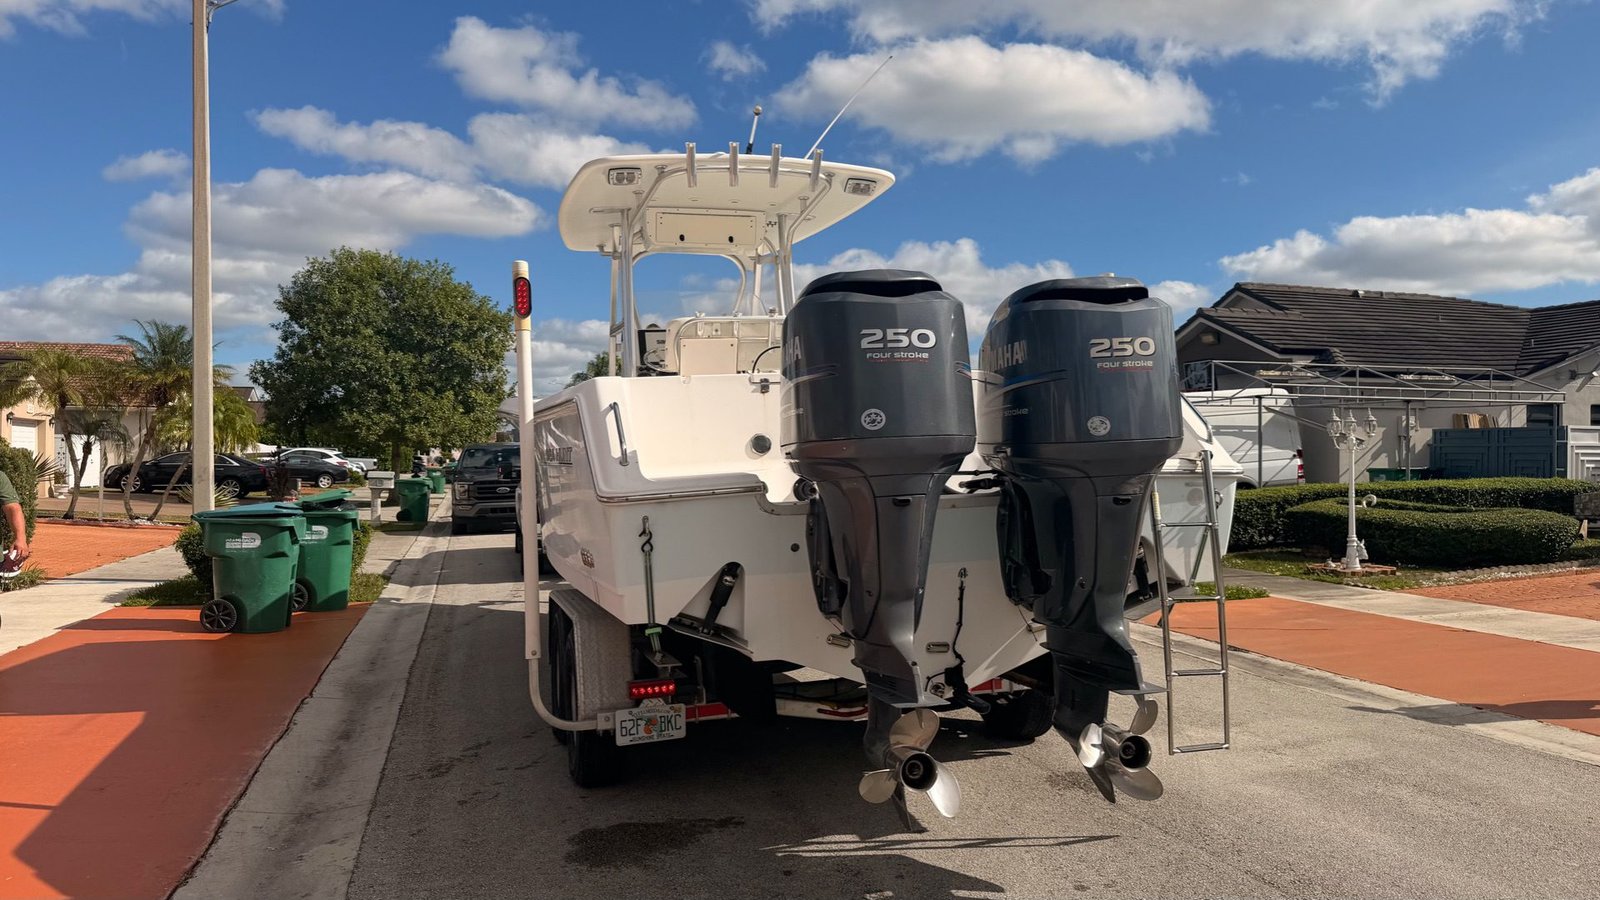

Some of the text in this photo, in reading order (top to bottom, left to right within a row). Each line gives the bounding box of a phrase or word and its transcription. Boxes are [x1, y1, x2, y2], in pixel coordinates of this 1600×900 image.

[860, 328, 937, 349] 250
[1089, 336, 1156, 358] 250
[620, 718, 643, 738] 62F
